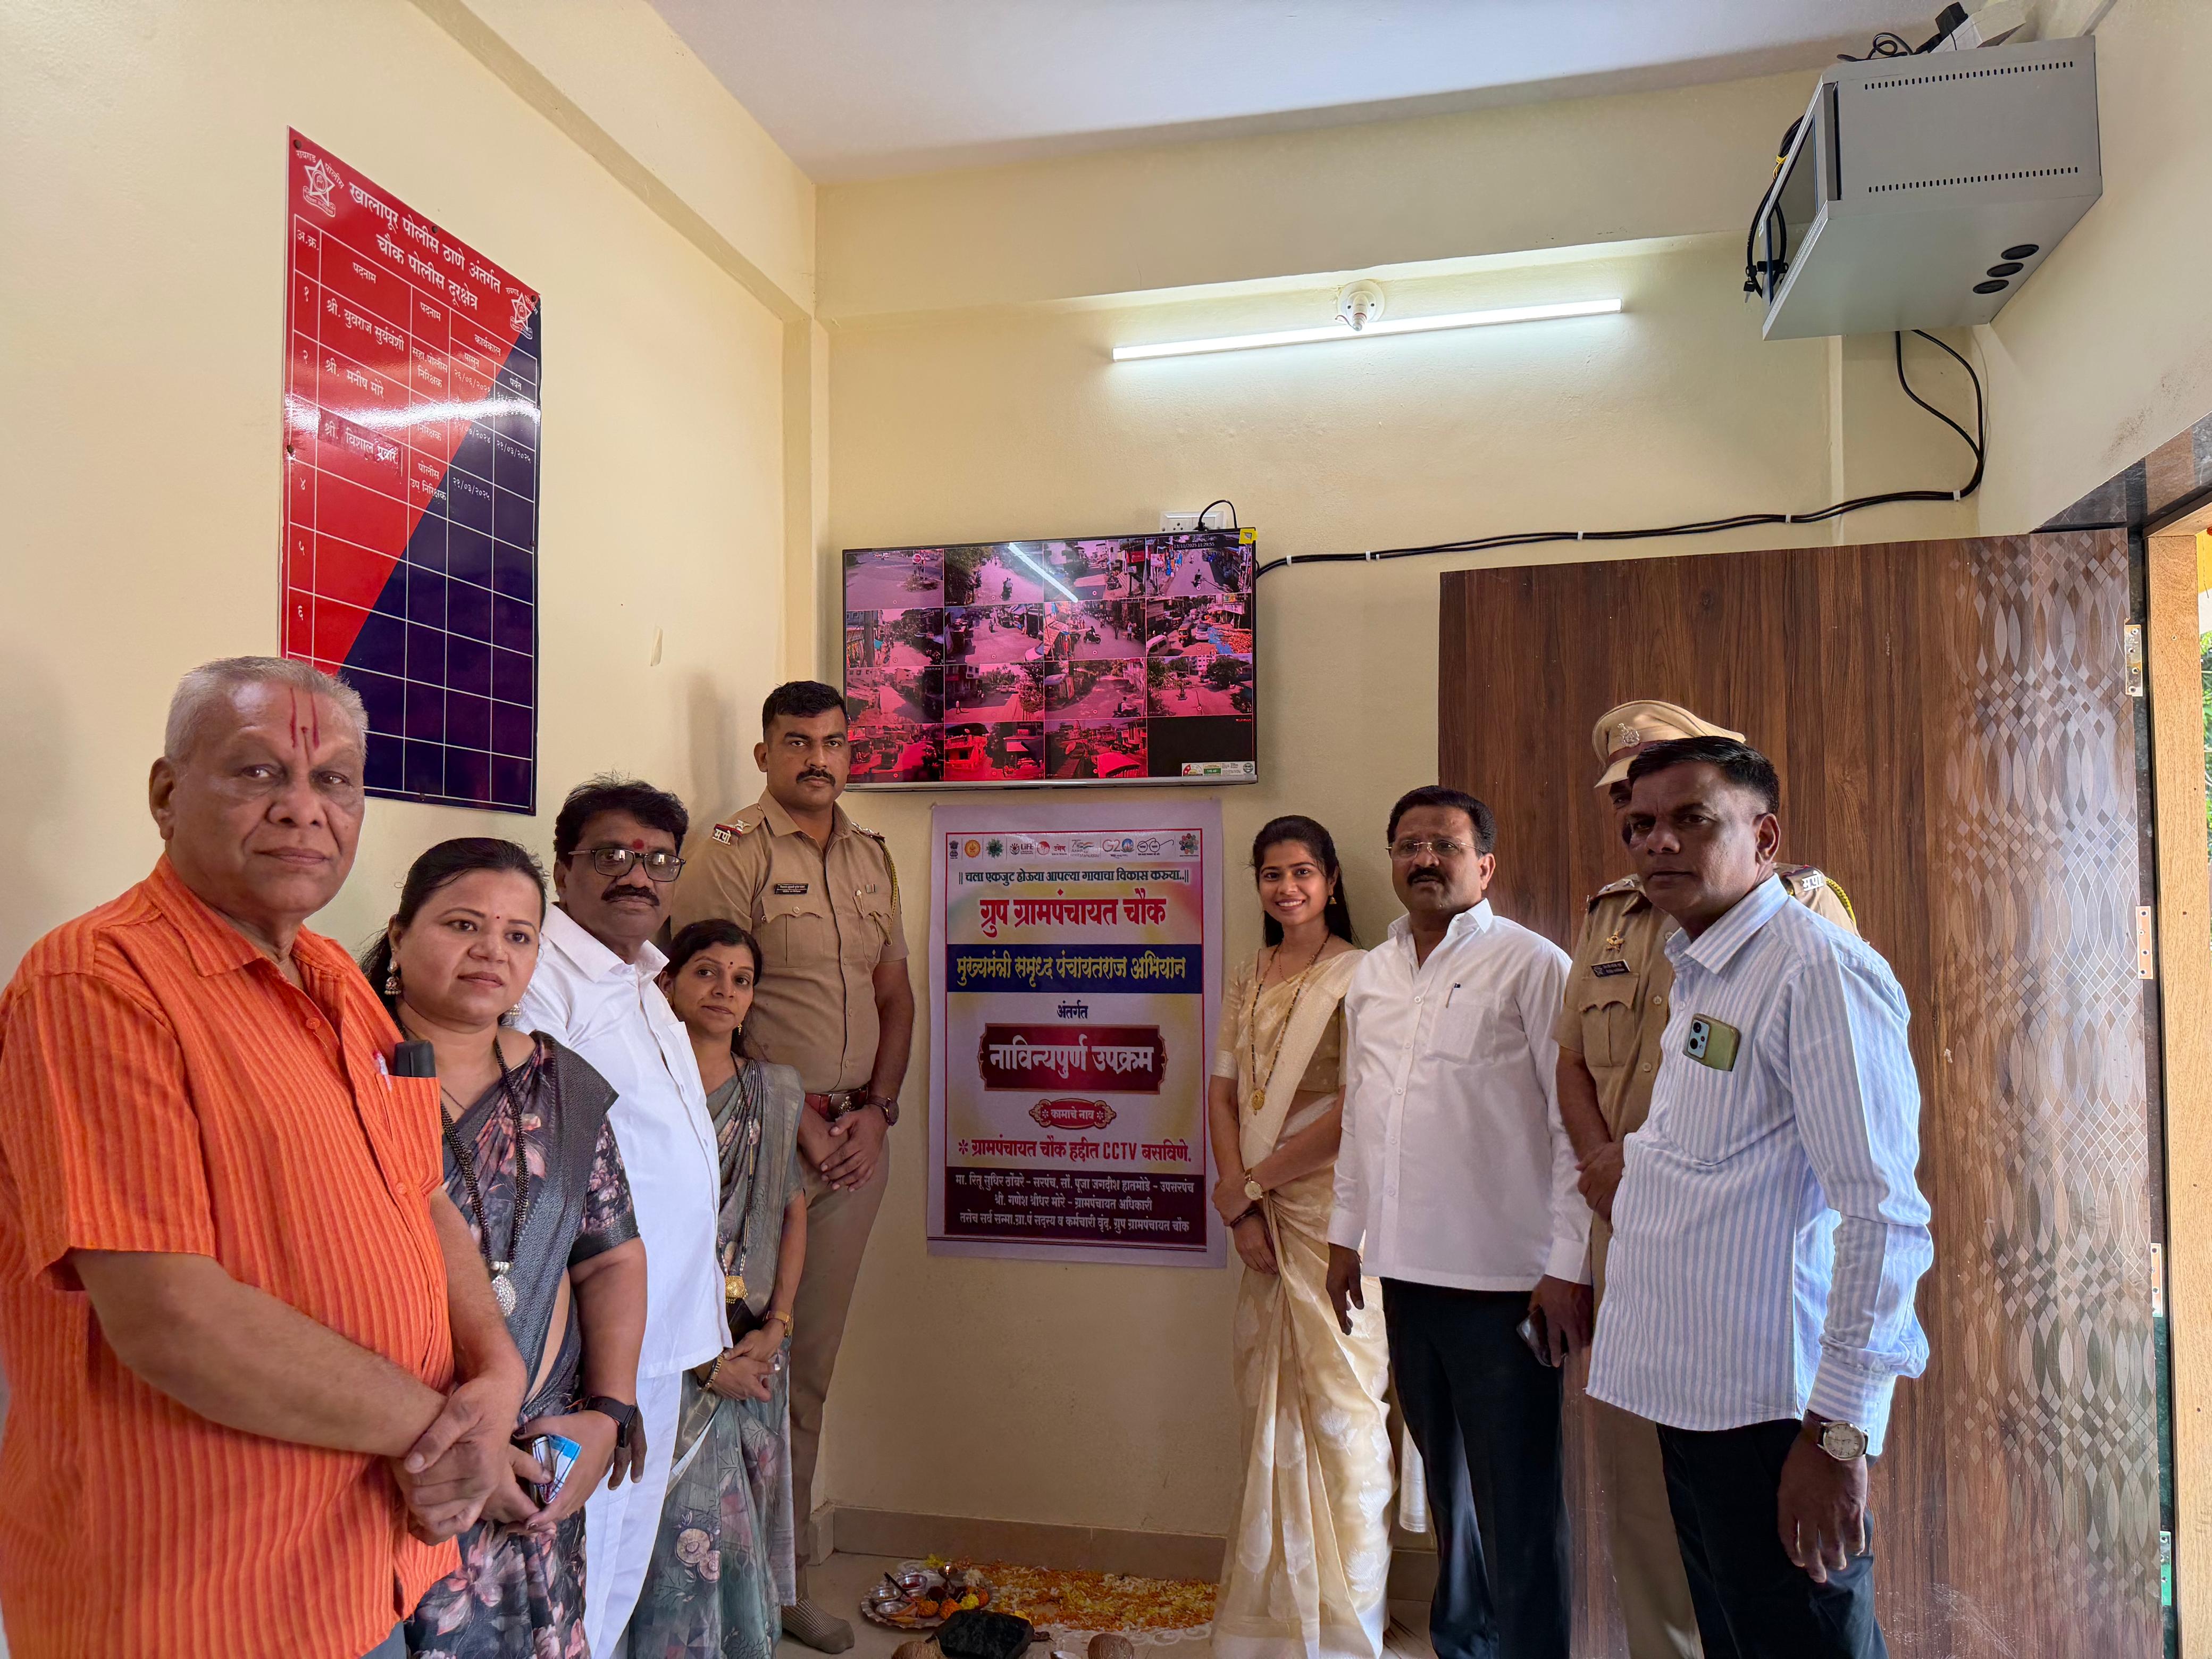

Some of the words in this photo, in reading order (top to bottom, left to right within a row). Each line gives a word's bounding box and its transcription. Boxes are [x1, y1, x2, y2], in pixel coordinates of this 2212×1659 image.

[349, 181, 399, 233] खालापूर
[403, 214, 439, 254] पोलीस
[442, 247, 465, 271] ठाणे
[468, 259, 501, 294] अंतर्गत
[297, 229, 319, 250] अ.क्र.
[353, 262, 376, 284] पदनाम
[420, 301, 441, 322] पदनाम
[376, 233, 405, 264] चौक
[408, 250, 445, 290] पोलीस
[448, 279, 478, 311] दूरक्षेत्र
[304, 286, 309, 302] १
[326, 297, 341, 317] श्री.
[343, 308, 372, 334] युवराज
[303, 349, 308, 365] २
[325, 357, 340, 377] श्री.
[346, 370, 368, 391] मनीष
[371, 378, 384, 399] मोरे
[417, 365, 442, 388] निरिक्षक
[324, 421, 339, 439] श्री.
[345, 427, 374, 454] विशाल
[417, 460, 440, 480] पोलीस
[300, 477, 306, 490] ४
[298, 540, 305, 556] ५
[298, 606, 304, 622] ६
[965, 872, 984, 882] चला
[985, 872, 1015, 886] एकजुट
[1016, 868, 1044, 883] होऊया
[1046, 871, 1080, 882] आपल्या
[1082, 871, 1114, 882] गावाचा
[1116, 867, 1149, 881] विकास
[979, 899, 1010, 938] ग्रुप
[1013, 889, 1119, 927] ग्रामपंचायत
[1122, 888, 1167, 925] चौक
[956, 949, 1012, 986] मुख्यमंत्री
[1055, 949, 1128, 979] पंचायतराज
[1130, 950, 1186, 979] अभियान
[1057, 999, 1089, 1019] अंतर्गत
[988, 1033, 1088, 1079] नाविन्यपुर्ण
[1091, 1045, 1154, 1075] उपक्रम
[1050, 1106, 1078, 1119] कामाचे
[1079, 1109, 1094, 1119] नाव
[971, 1134, 1038, 1158] ग्रामपंचायत
[1040, 1135, 1068, 1158] चौक
[1068, 1136, 1100, 1162] हद्दीत
[1103, 1142, 1137, 1160] CCTV
[956, 1174, 967, 1185] मा.
[969, 1171, 984, 1191] रितू
[984, 1172, 1004, 1191] सुधिर
[1075, 1178, 1091, 1193] पूजा
[1092, 1176, 1120, 1192] जगदीश
[1121, 1177, 1150, 1193] हातमोडे
[1160, 1178, 1194, 1193] उपसरपंच
[995, 1191, 1006, 1206] श्री.
[1008, 1191, 1028, 1206] गणेश
[1030, 1192, 1050, 1207] श्रीधर
[1051, 1193, 1066, 1208] मोरे
[1075, 1194, 1117, 1209] ग्रामपंचायत
[1118, 1195, 1153, 1211] अधिकारी
[960, 1209, 978, 1223] तसेच
[980, 1209, 992, 1224] सर्व
[1034, 1214, 1056, 1228] सदस्य
[1058, 1216, 1063, 1226] व
[1065, 1212, 1096, 1228] कर्मचारी
[1113, 1218, 1126, 1234] ग्रुप
[1128, 1216, 1170, 1231] ग्रामपंचायत
[1171, 1217, 1190, 1232] चौक
